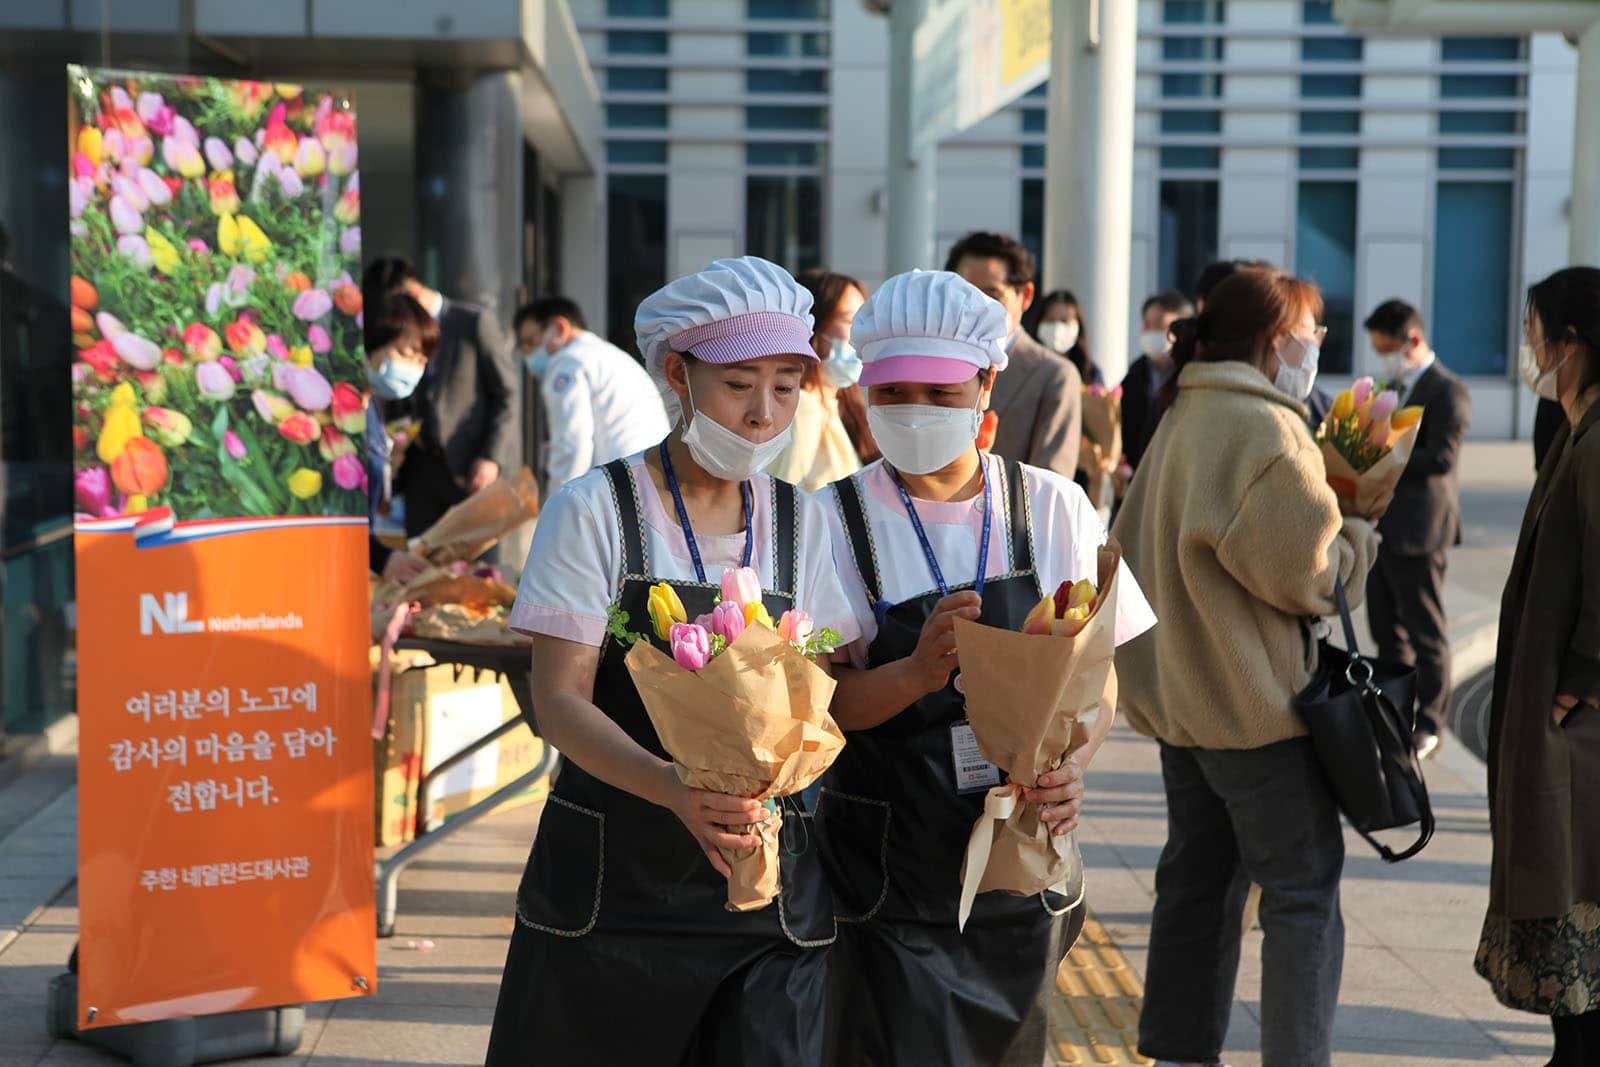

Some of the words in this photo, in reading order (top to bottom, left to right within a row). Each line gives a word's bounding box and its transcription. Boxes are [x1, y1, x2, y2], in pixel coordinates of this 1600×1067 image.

[139, 592, 205, 635] NL
[208, 612, 304, 632] Netherlands
[126, 687, 230, 723] 여러분의
[238, 682, 317, 713] 노고에
[109, 735, 187, 771] 감사의
[195, 732, 276, 764] 마음을
[283, 726, 337, 757] 담아
[167, 775, 280, 812] 전합니다.
[140, 868, 178, 892] 주한
[182, 856, 310, 887] 네덜란드대사관
